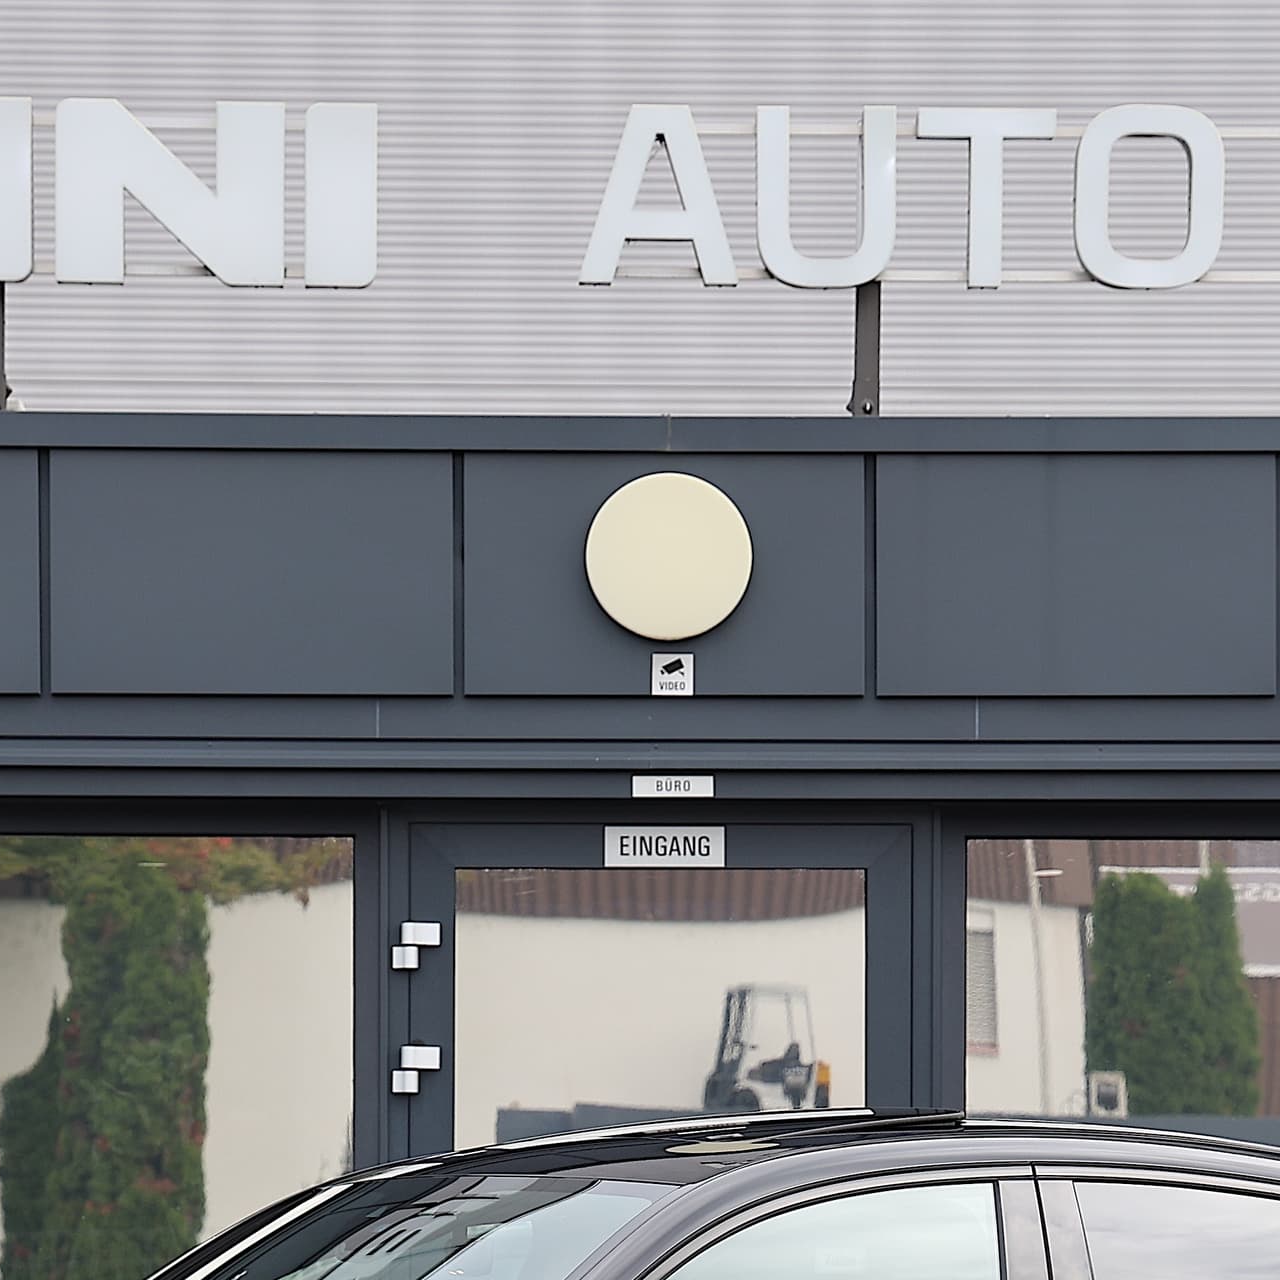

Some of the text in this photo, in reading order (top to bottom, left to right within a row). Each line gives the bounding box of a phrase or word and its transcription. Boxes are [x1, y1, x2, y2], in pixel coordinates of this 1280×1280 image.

[579, 102, 1227, 289] AUTO
[659, 681, 686, 691] VIDEO
[656, 778, 691, 792] BÜRO
[619, 835, 711, 857] EINGANG
